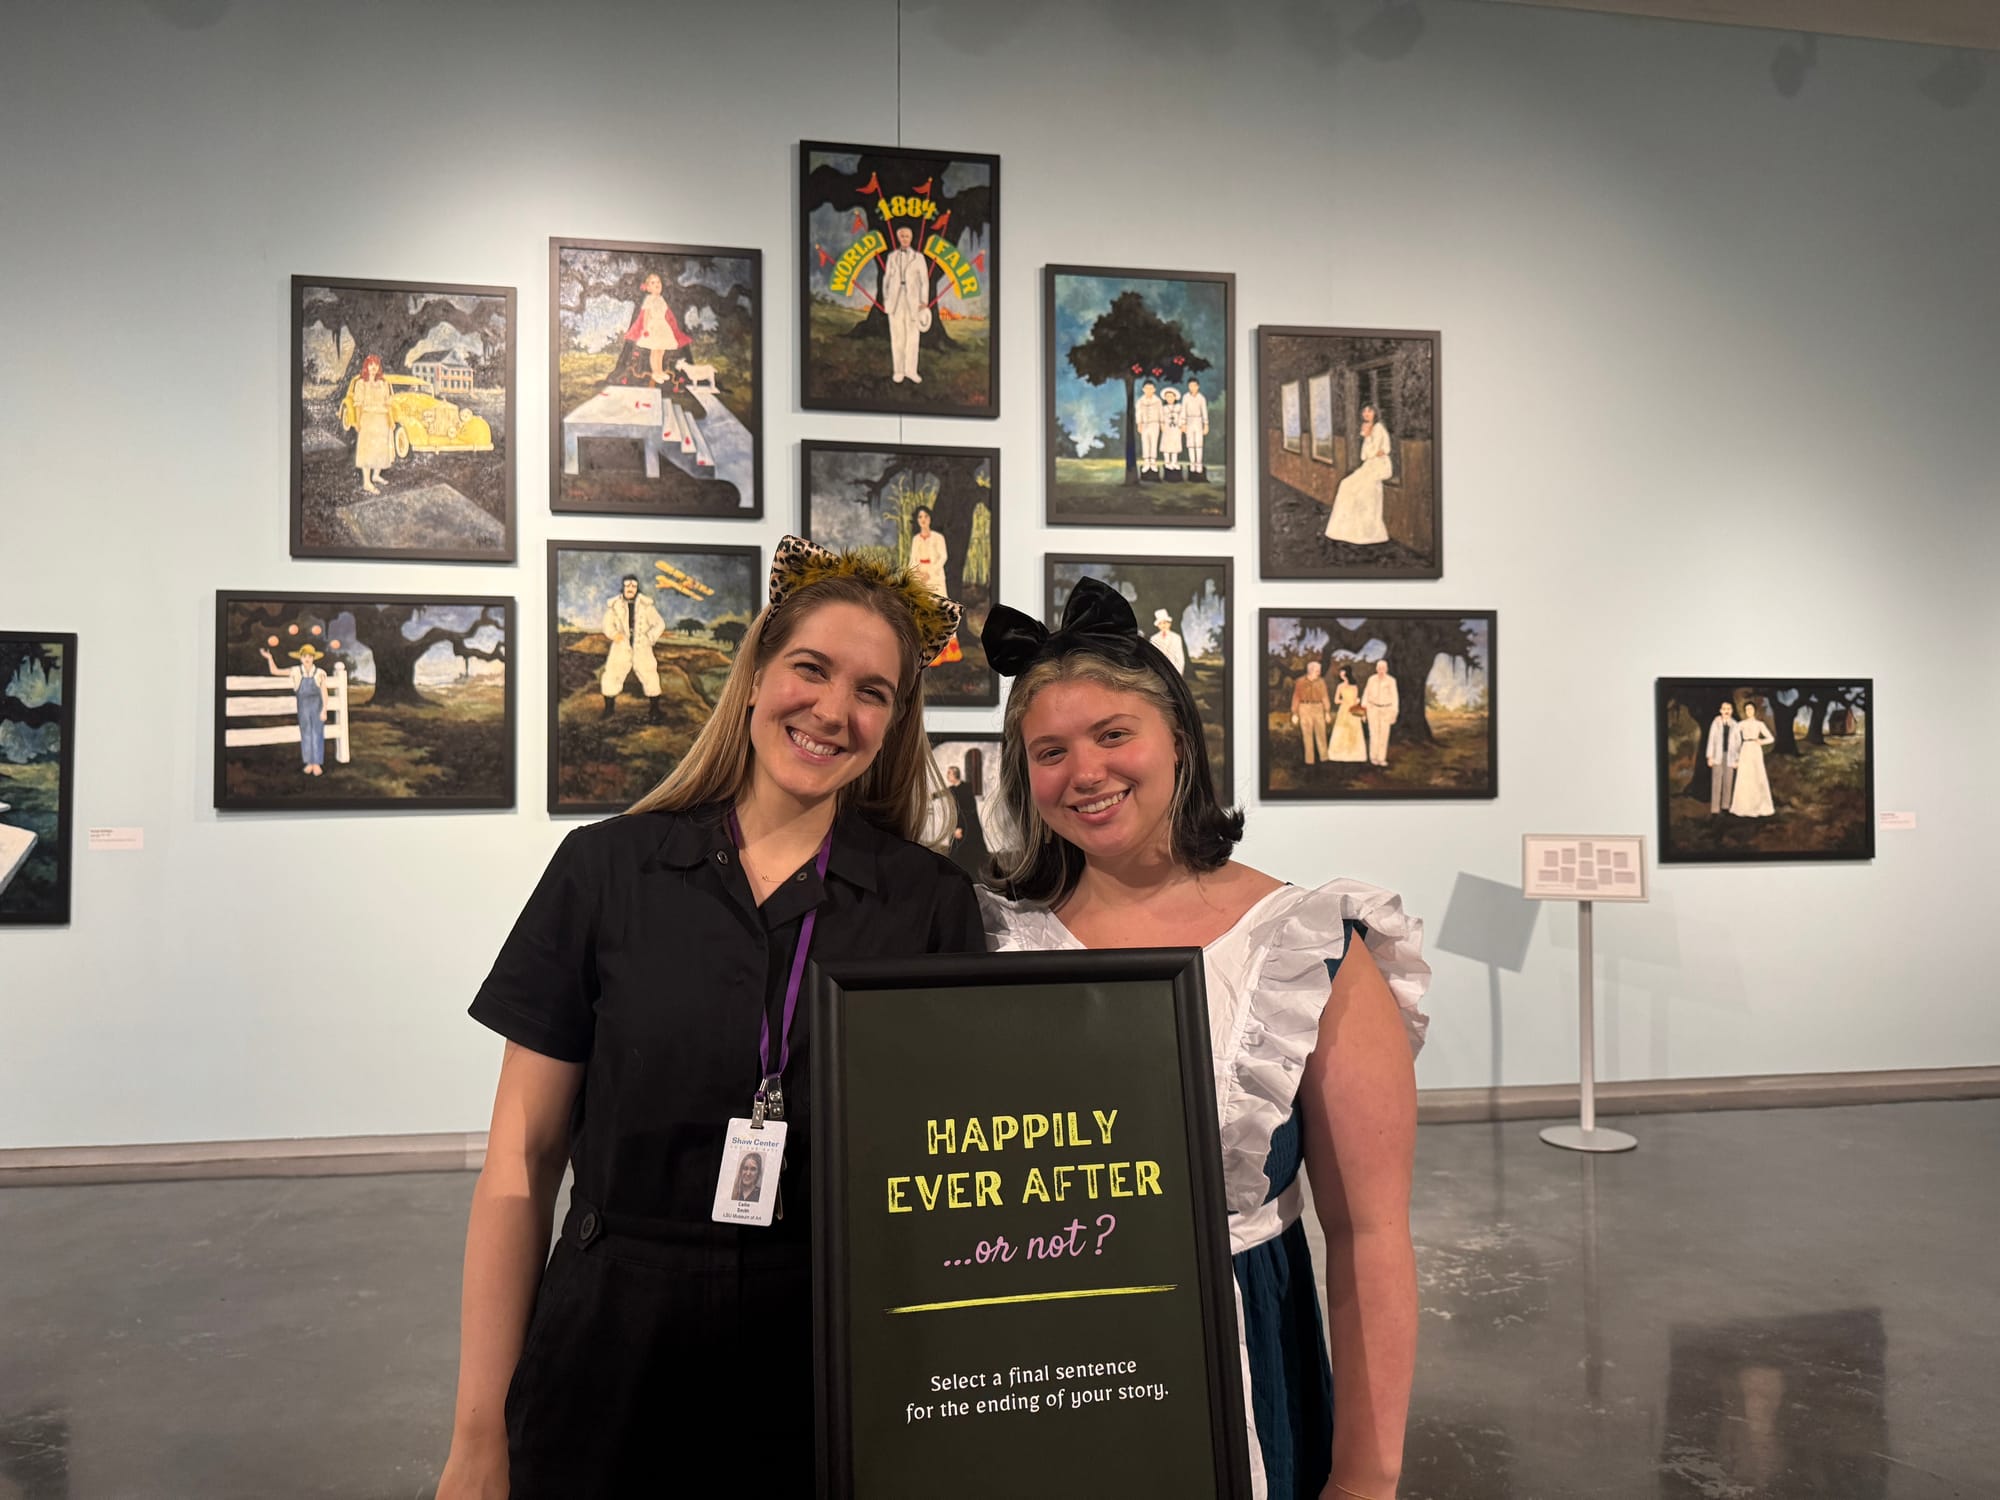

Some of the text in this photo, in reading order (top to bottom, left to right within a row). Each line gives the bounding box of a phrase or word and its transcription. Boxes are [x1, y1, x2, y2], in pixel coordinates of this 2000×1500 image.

[877, 195, 937, 221] 1884
[830, 234, 978, 295] WORLD FAIR
[732, 1137, 780, 1147] Shaw Center
[927, 1109, 1118, 1155] HAPPILY
[887, 1160, 1163, 1213] EVER AFTER
[931, 1360, 1137, 1392] Select a final sentence
[905, 1382, 1169, 1424] for the ending of your story.
